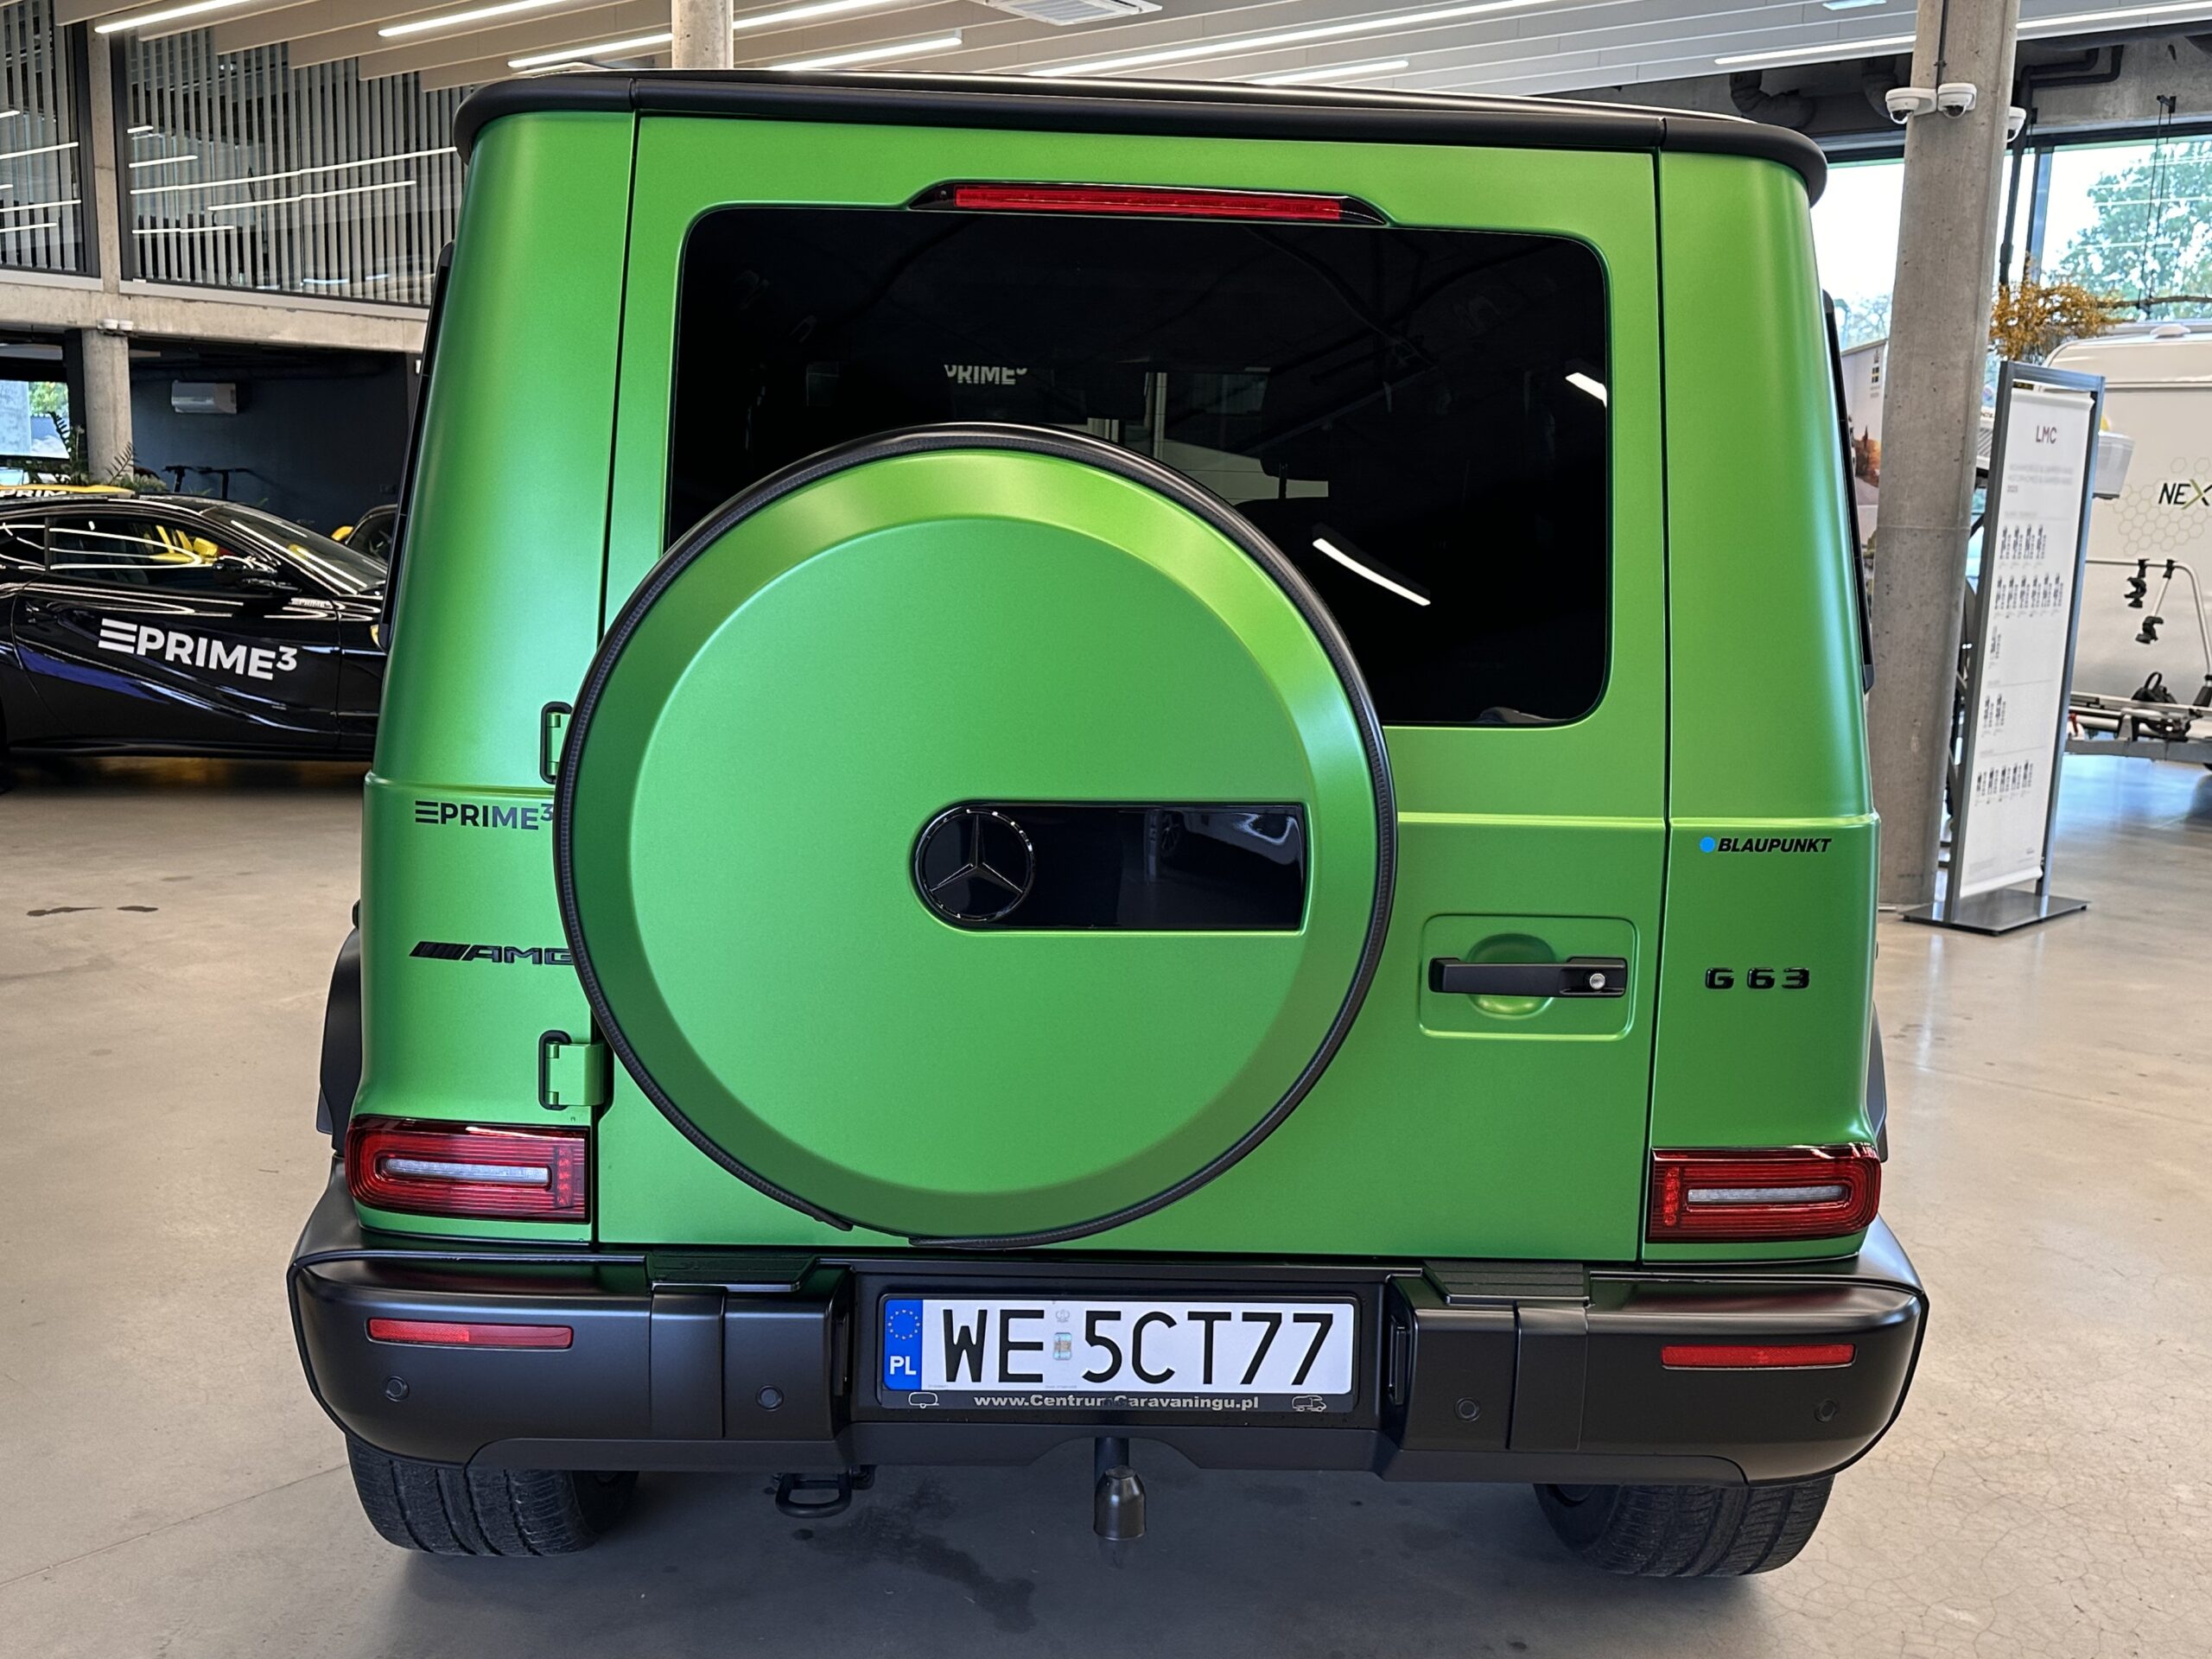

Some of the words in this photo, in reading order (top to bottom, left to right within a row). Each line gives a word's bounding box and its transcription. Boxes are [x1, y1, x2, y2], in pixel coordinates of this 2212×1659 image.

[2036, 425, 2057, 444] LMC
[1717, 837, 1832, 853] BLAUPUNKT
[461, 944, 575, 966] AMG
[1705, 967, 1735, 989] G
[1746, 967, 1810, 989] 63
[943, 1309, 1045, 1383] WE
[1082, 1310, 1334, 1385] 5CT77
[889, 1356, 917, 1376] PL
